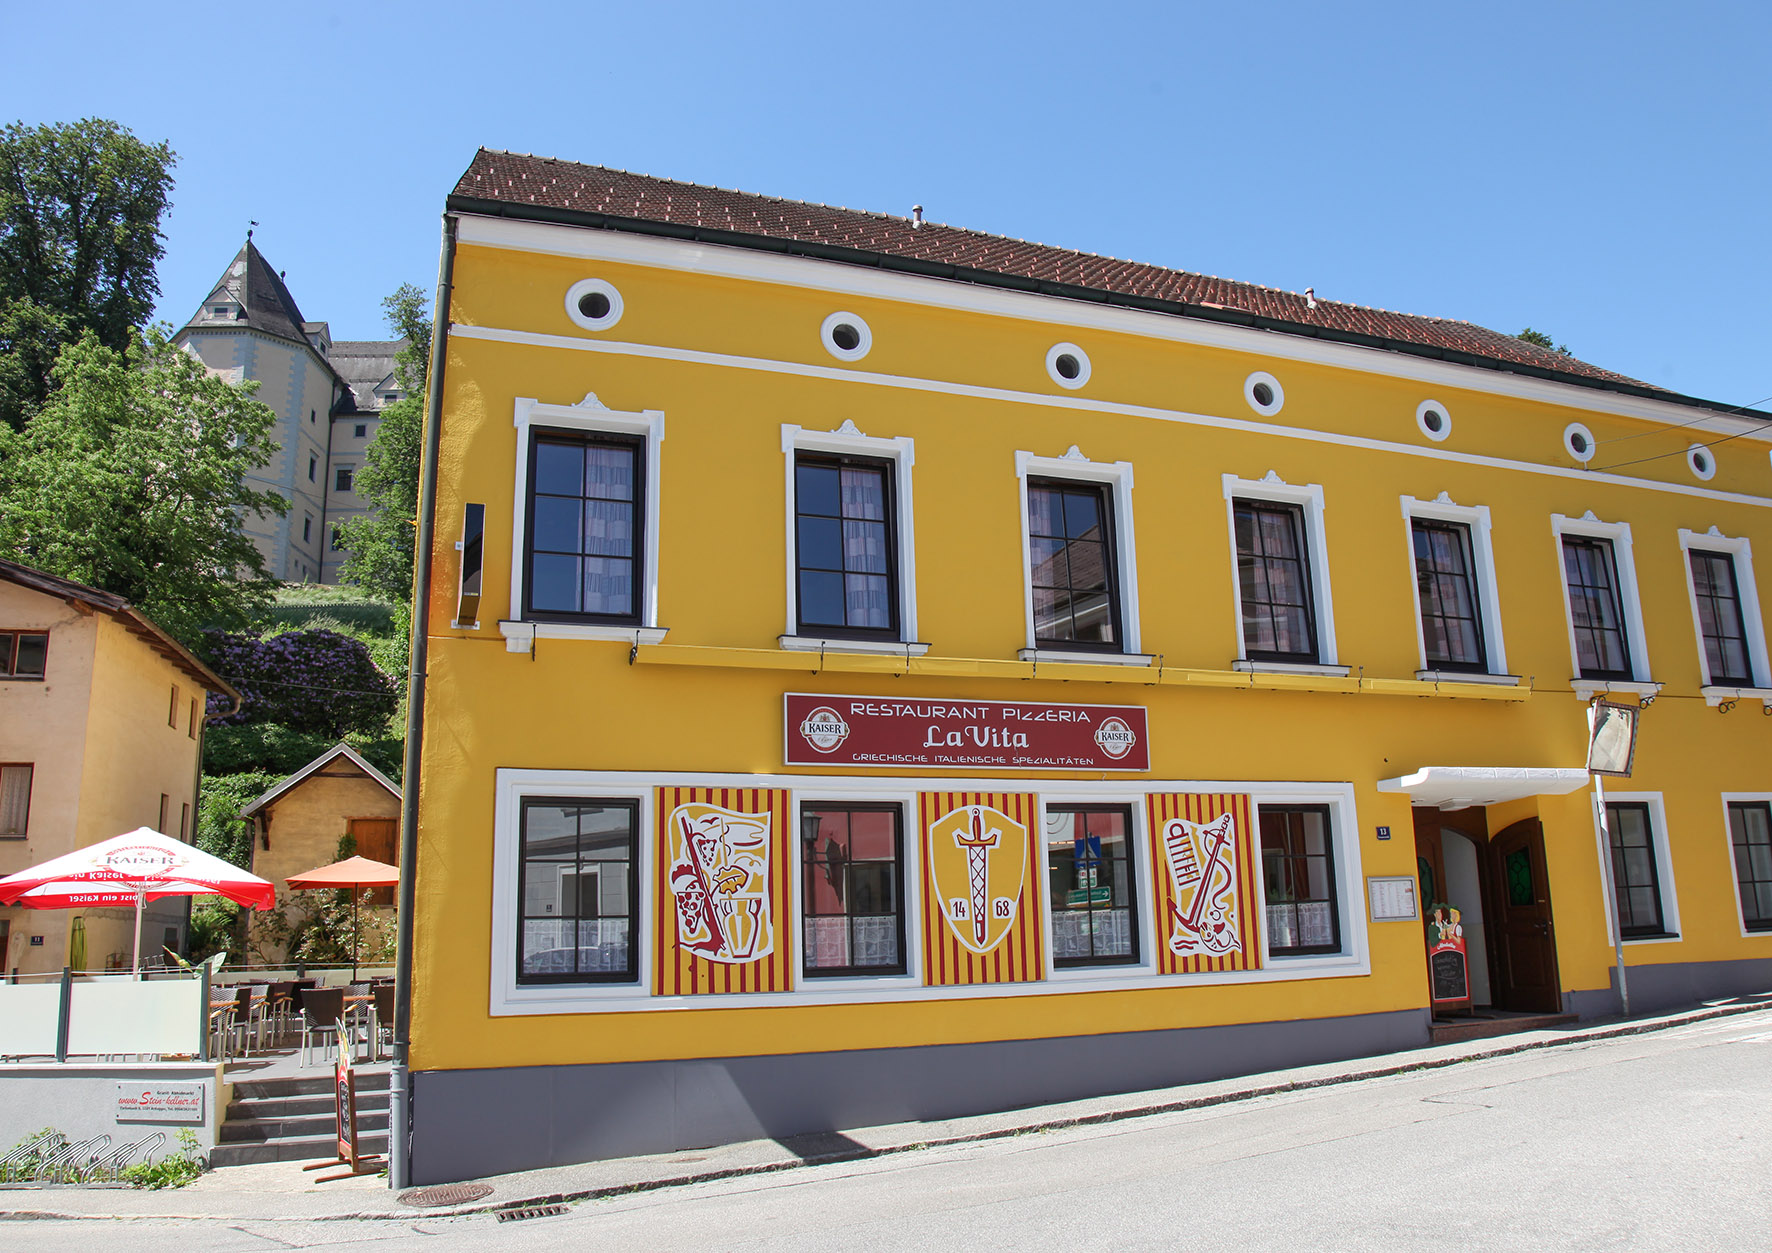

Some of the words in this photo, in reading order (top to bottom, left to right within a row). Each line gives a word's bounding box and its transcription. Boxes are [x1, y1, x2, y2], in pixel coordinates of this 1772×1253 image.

[850, 703, 989, 720] RESTAURANT
[1002, 707, 1091, 723] PIZZERIA
[808, 723, 842, 734] KAISER
[1101, 731, 1129, 742] KAISER
[852, 753, 928, 763] GRIECHISCHE
[934, 755, 1006, 765] ITALIENISCHE
[1012, 756, 1094, 766] SPEZIALITÄTEN
[106, 856, 174, 865] KAISER
[953, 901, 966, 917] 14
[996, 900, 1010, 917] 68
